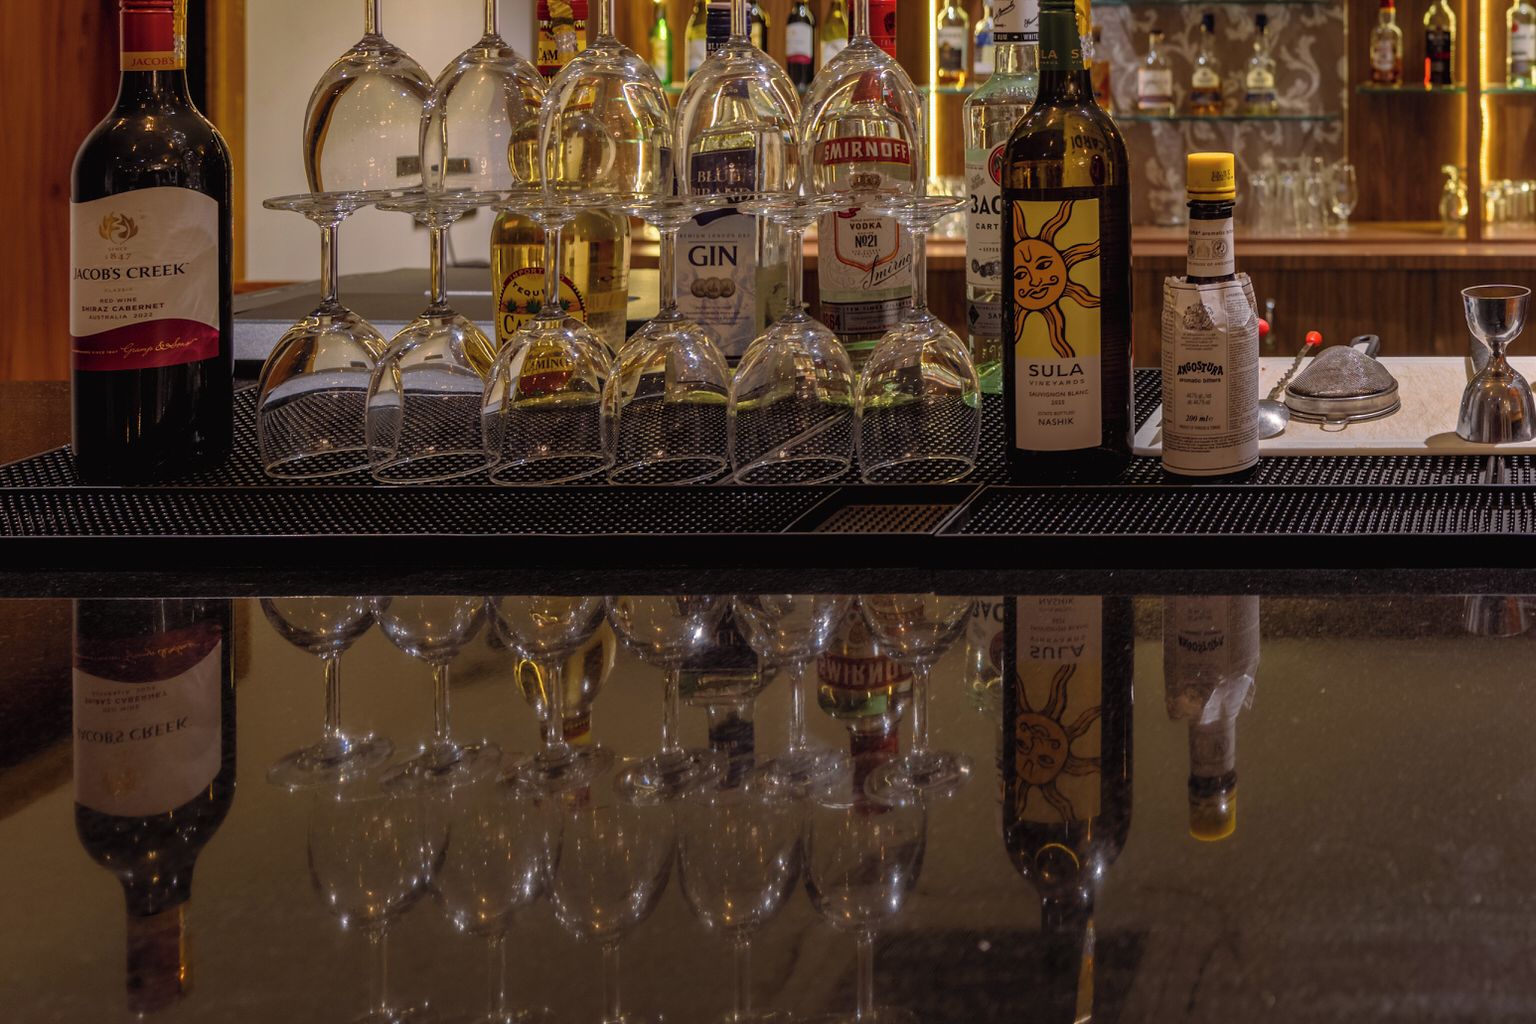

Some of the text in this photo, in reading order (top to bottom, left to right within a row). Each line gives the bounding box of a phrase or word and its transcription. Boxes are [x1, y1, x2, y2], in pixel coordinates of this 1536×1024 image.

[131, 57, 175, 66] JACOB'S
[824, 140, 908, 161] SMIRNOFF
[849, 221, 882, 231] VODKA
[975, 222, 999, 230] CART
[688, 245, 738, 267] GIN
[74, 263, 186, 281] JACOB'S CREEK
[81, 302, 165, 313] SHIRAZ CABERNET
[1029, 363, 1084, 377] SULA
[1177, 361, 1224, 375] ANGOSTURA
[1038, 417, 1074, 426] NASHIK
